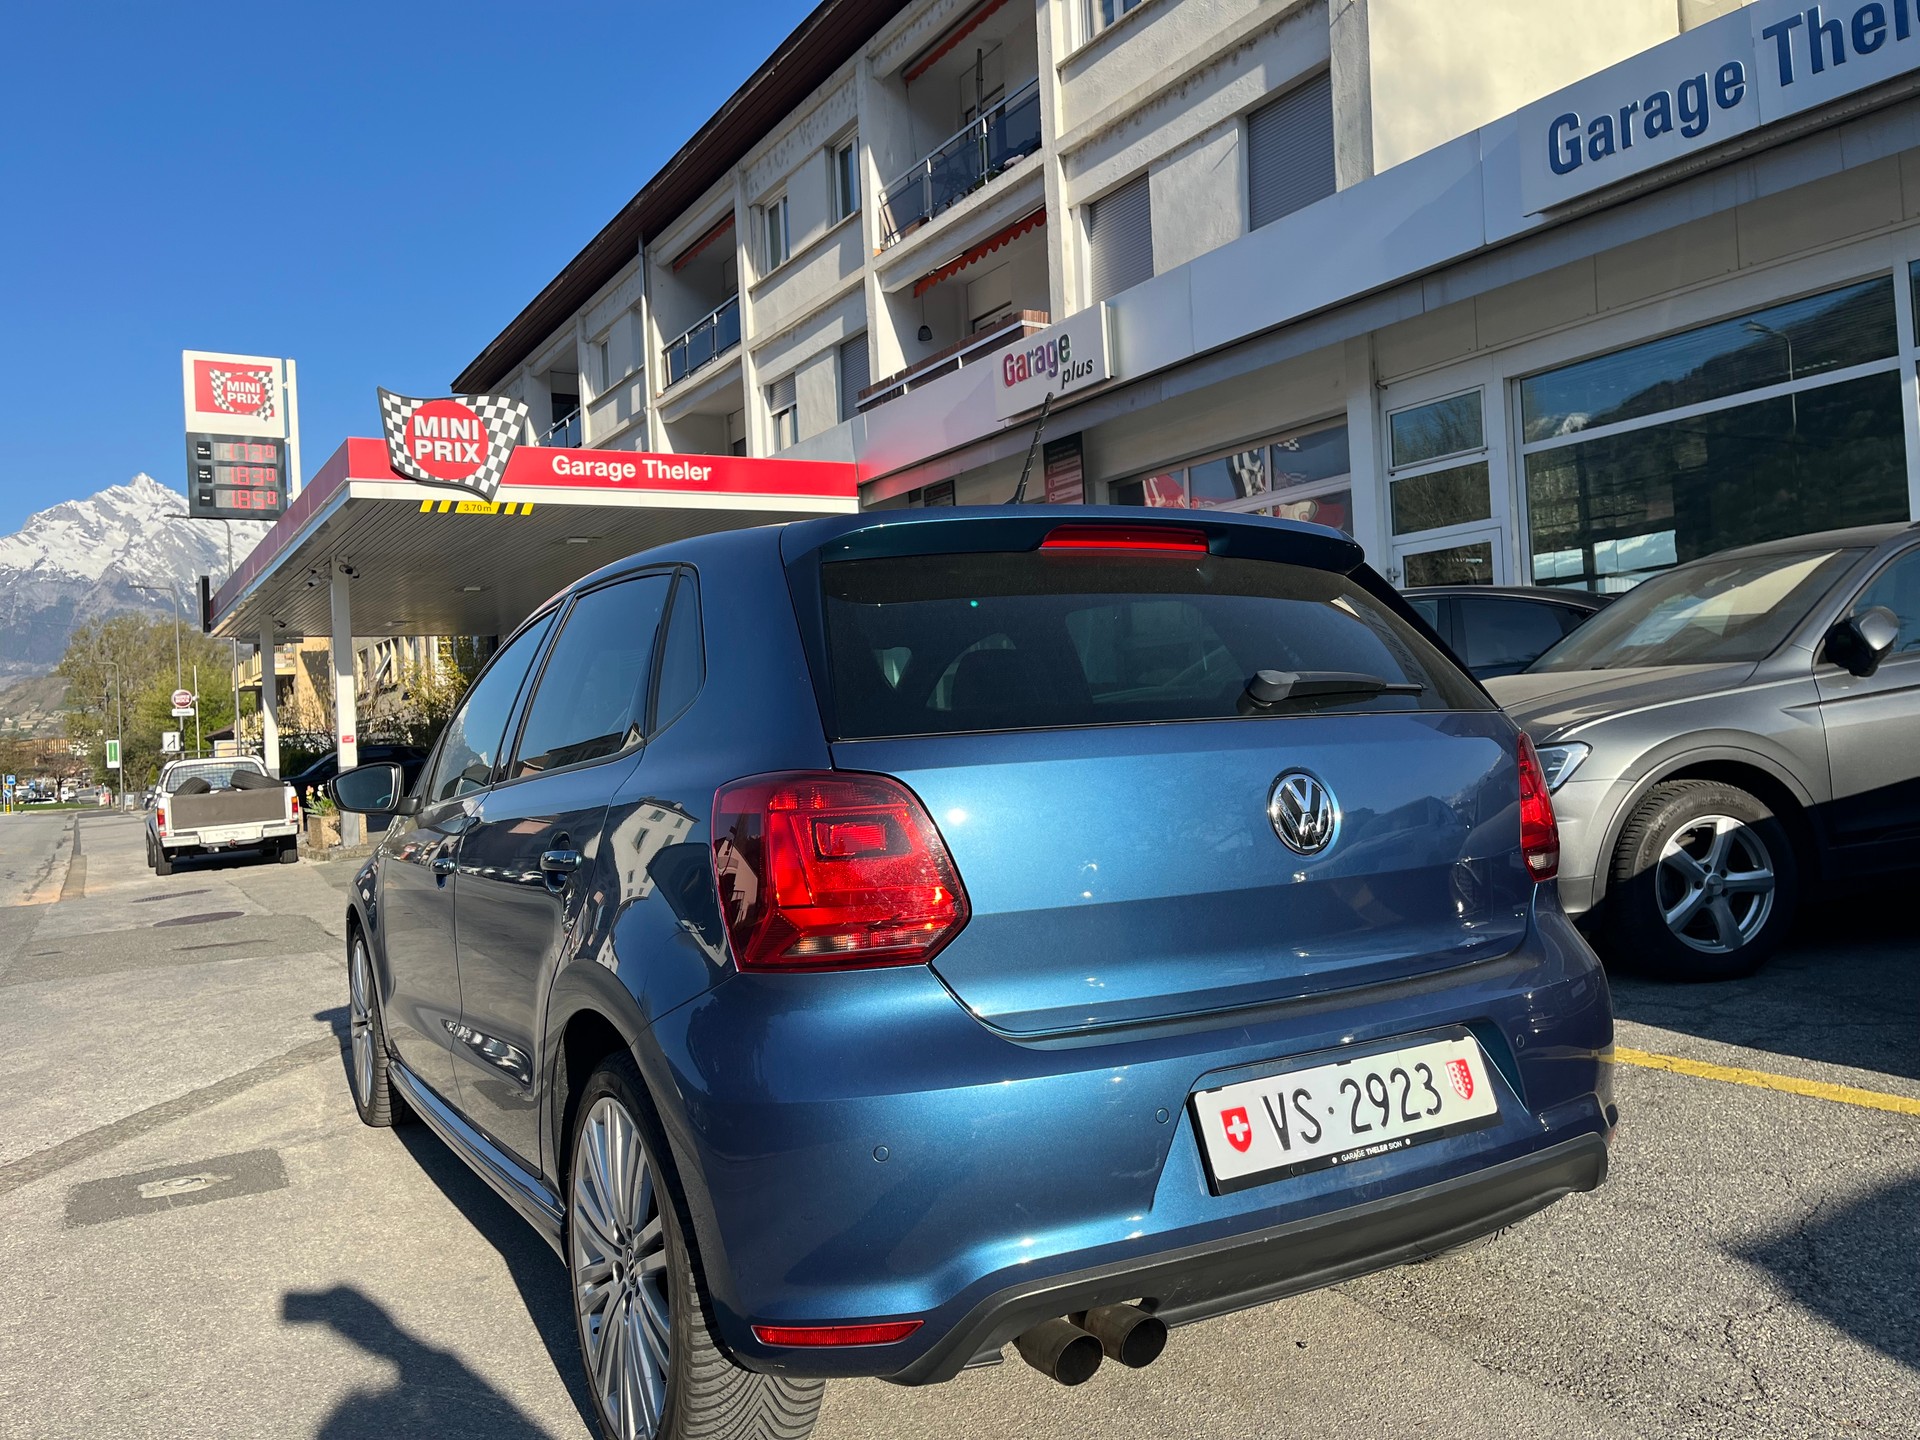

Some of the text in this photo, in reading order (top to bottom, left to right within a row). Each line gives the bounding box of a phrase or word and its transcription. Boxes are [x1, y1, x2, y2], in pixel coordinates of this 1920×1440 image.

[1547, 0, 1920, 177] Garage Thel
[1003, 333, 1072, 389] Garage
[1061, 358, 1094, 390] plus
[226, 380, 261, 394] MINI
[226, 391, 262, 405] PRIX
[413, 415, 480, 441] MINI
[414, 438, 481, 464] PRIX
[551, 454, 713, 482] Garage Theler
[1341, 1140, 1403, 1162] GARAGE THELER SION
